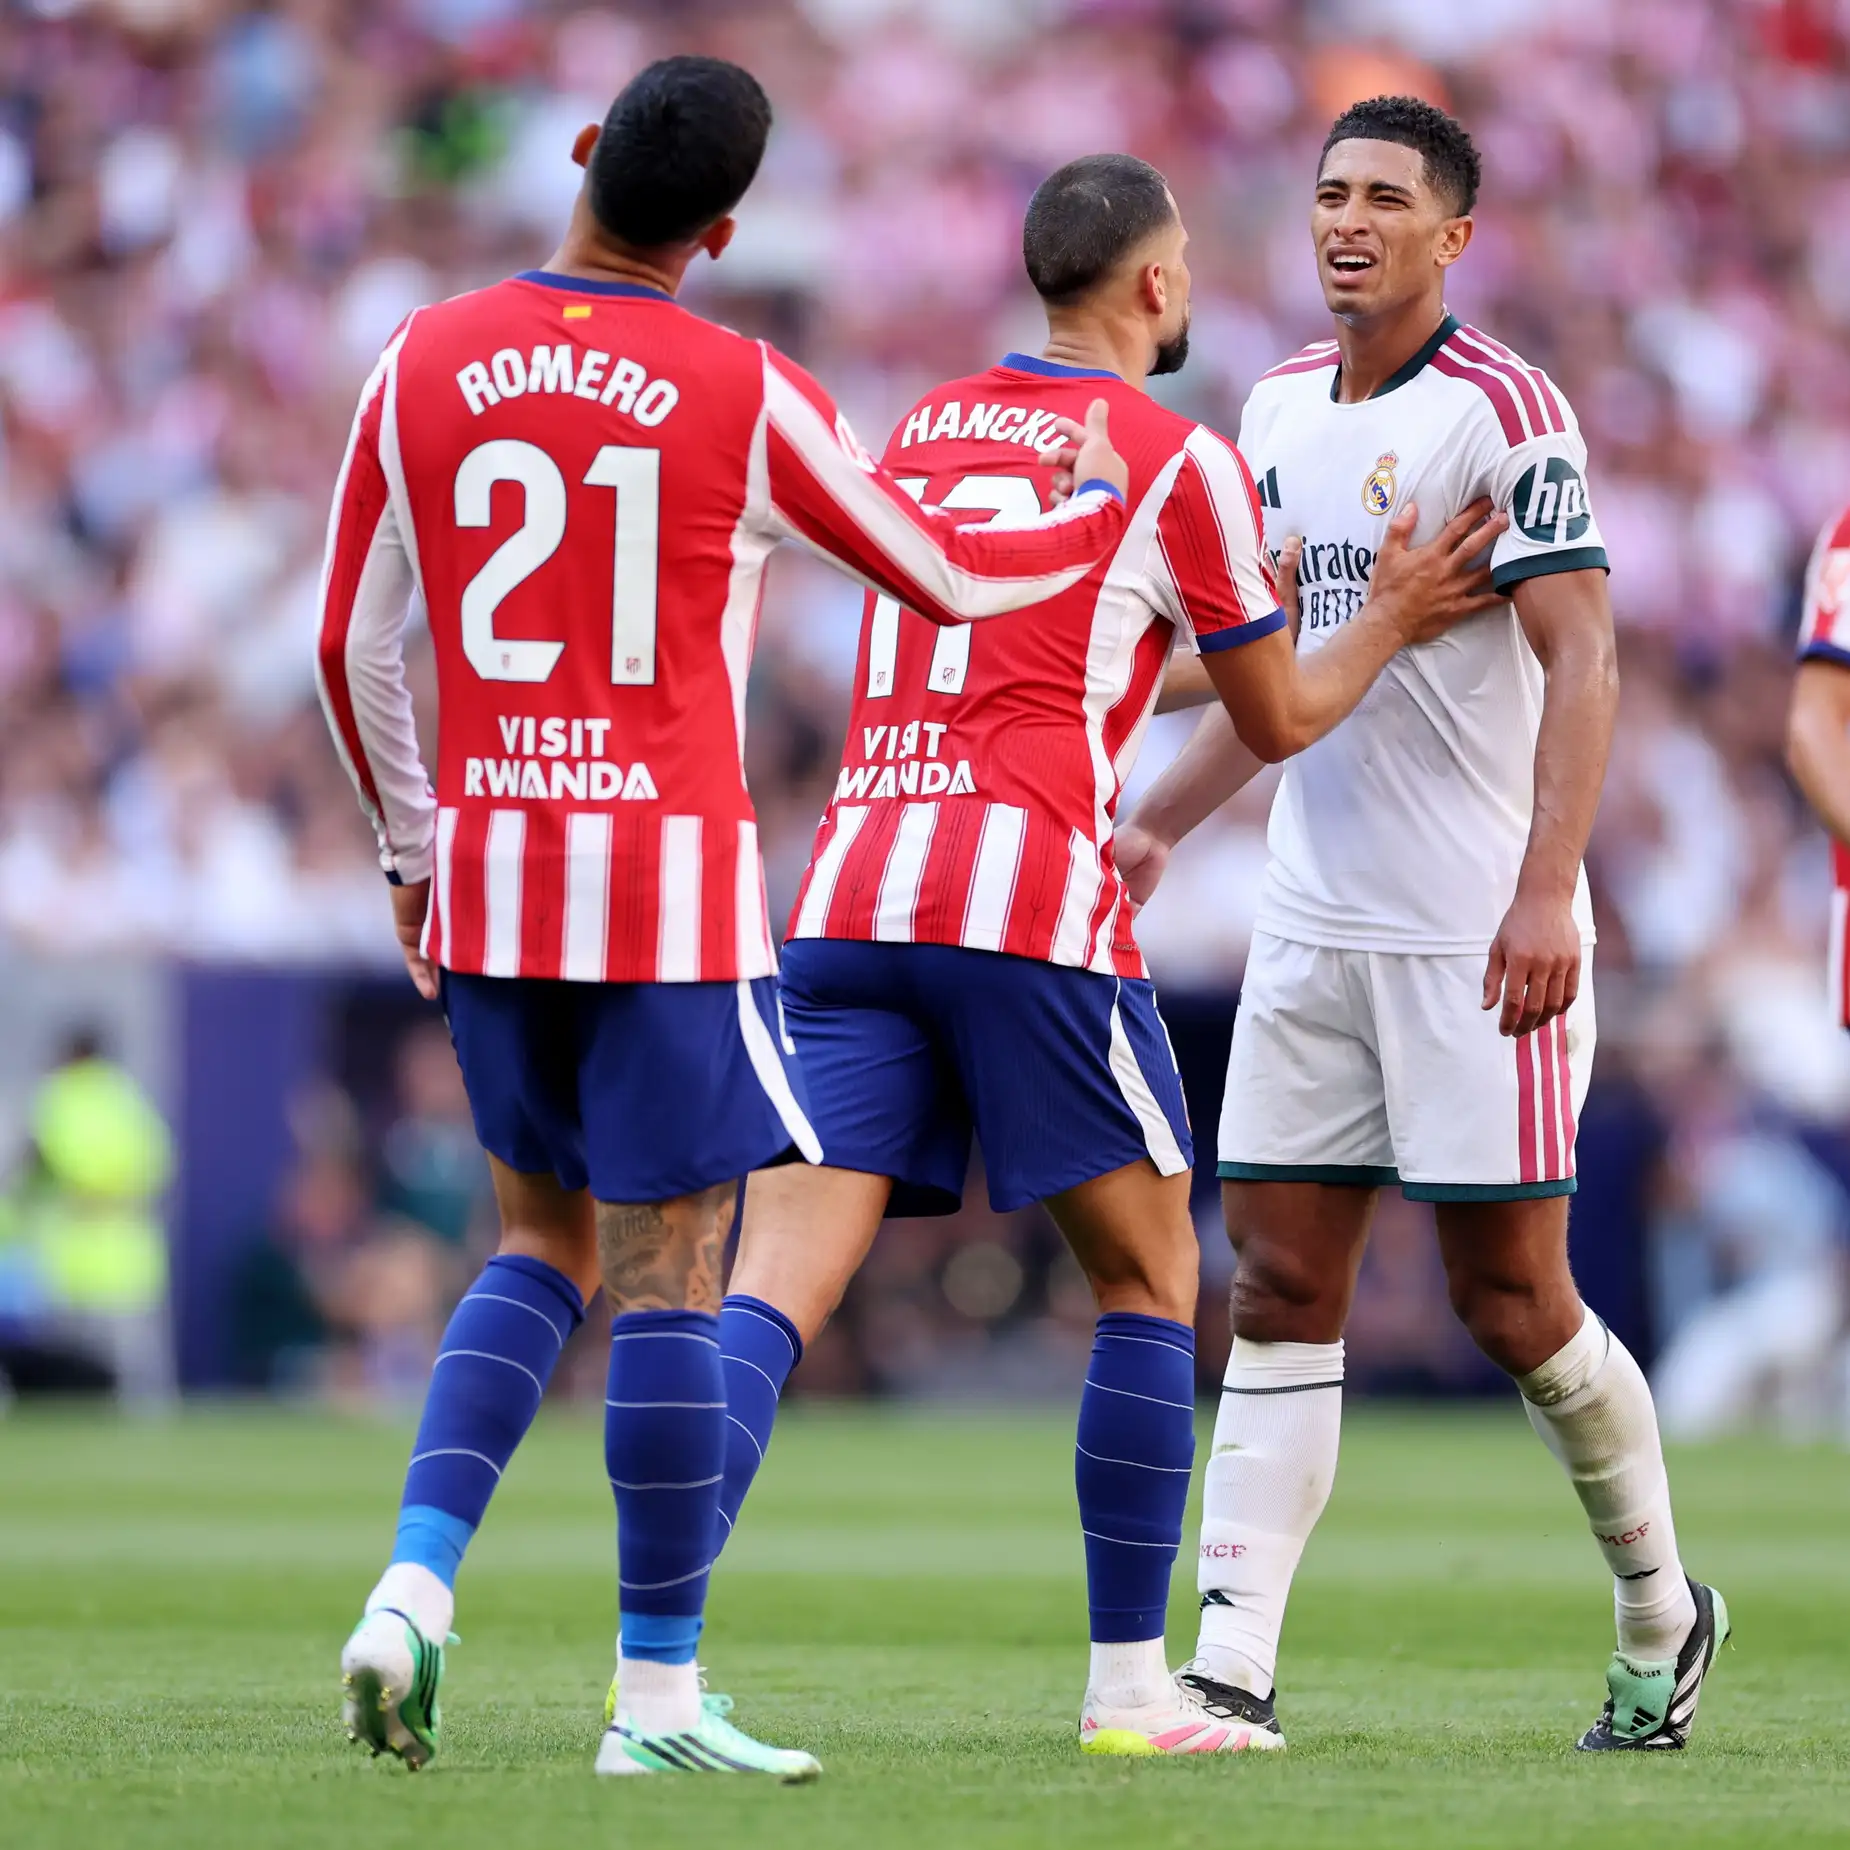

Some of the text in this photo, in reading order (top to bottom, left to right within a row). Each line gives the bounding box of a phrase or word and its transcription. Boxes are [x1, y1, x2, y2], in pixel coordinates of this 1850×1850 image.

[455, 344, 680, 427] ROMERO
[1523, 458, 1586, 544] hp
[453, 437, 661, 686] 21
[1268, 535, 1378, 587] irate
[1310, 588, 1368, 630] BETT
[498, 716, 611, 758] VISIT
[465, 760, 659, 801] RWANDA
